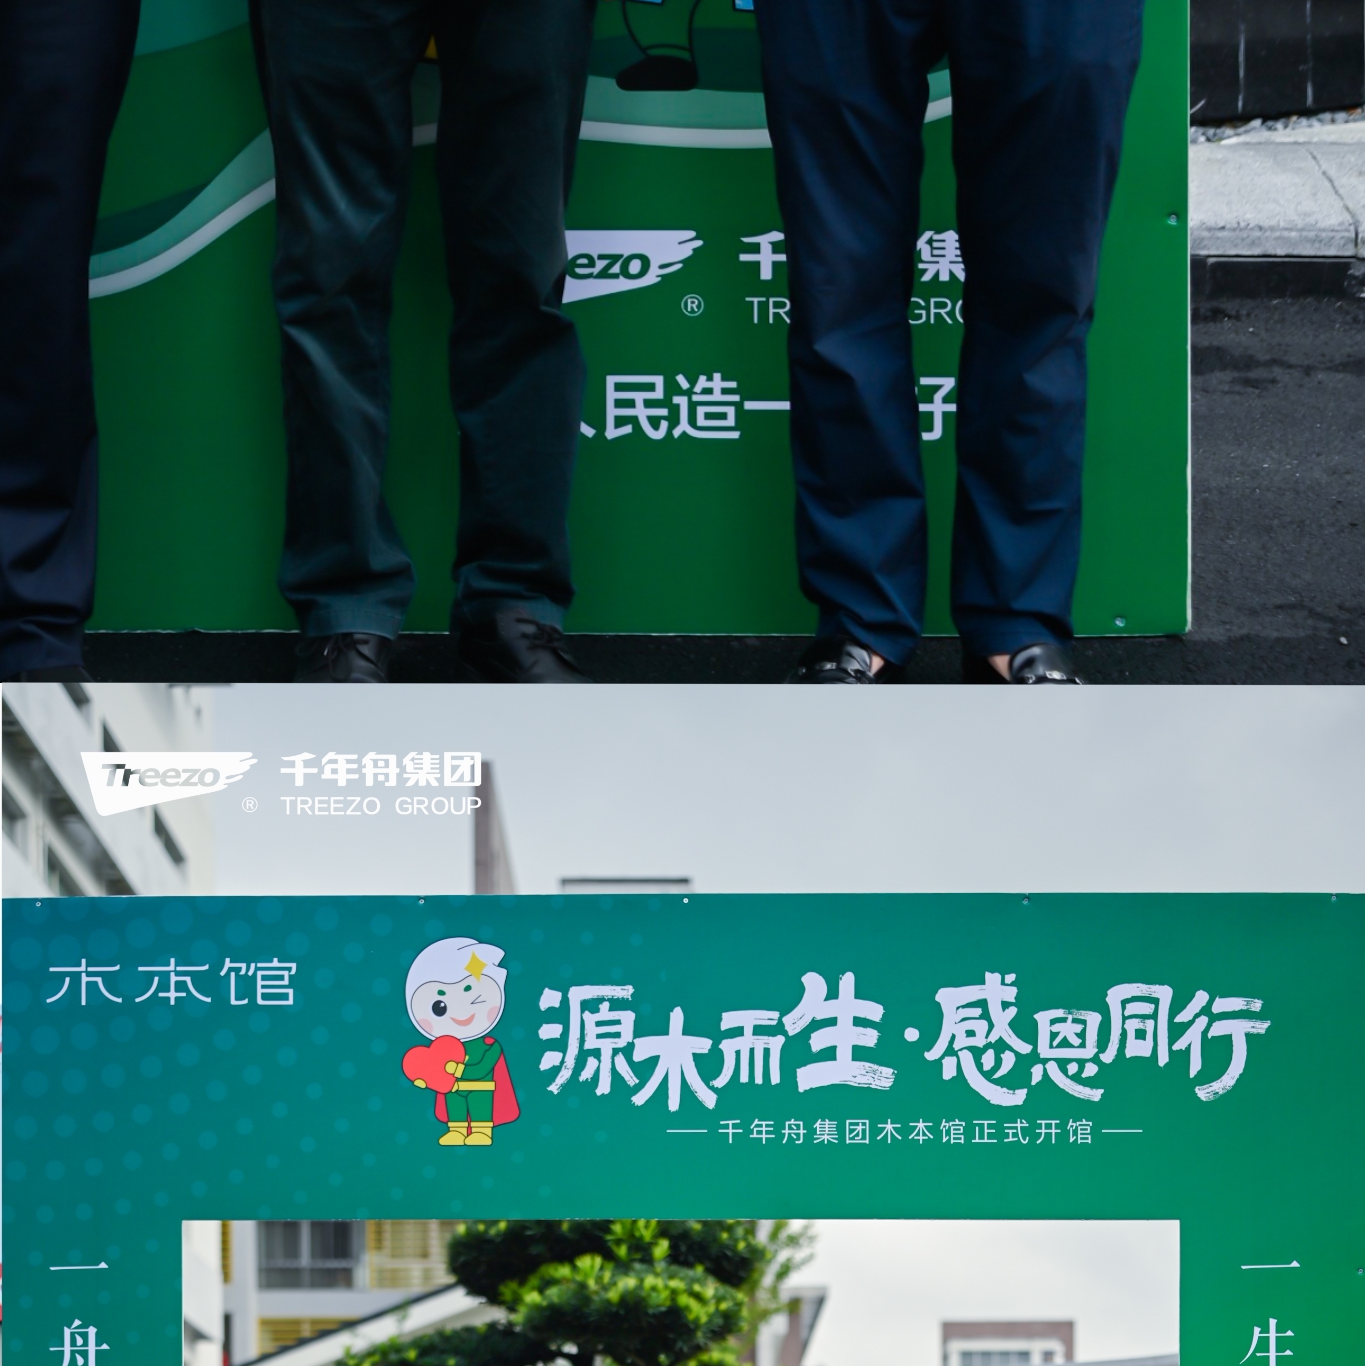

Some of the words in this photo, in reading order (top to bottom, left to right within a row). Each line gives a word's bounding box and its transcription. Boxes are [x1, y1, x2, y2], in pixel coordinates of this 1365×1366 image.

[568, 251, 651, 280] ezo
[46, 957, 297, 1006] 木本馆
[539, 971, 1270, 1113] 源木而生·感恩同行
[718, 1118, 1094, 1145] 千年舟集团木本馆正式开馆
